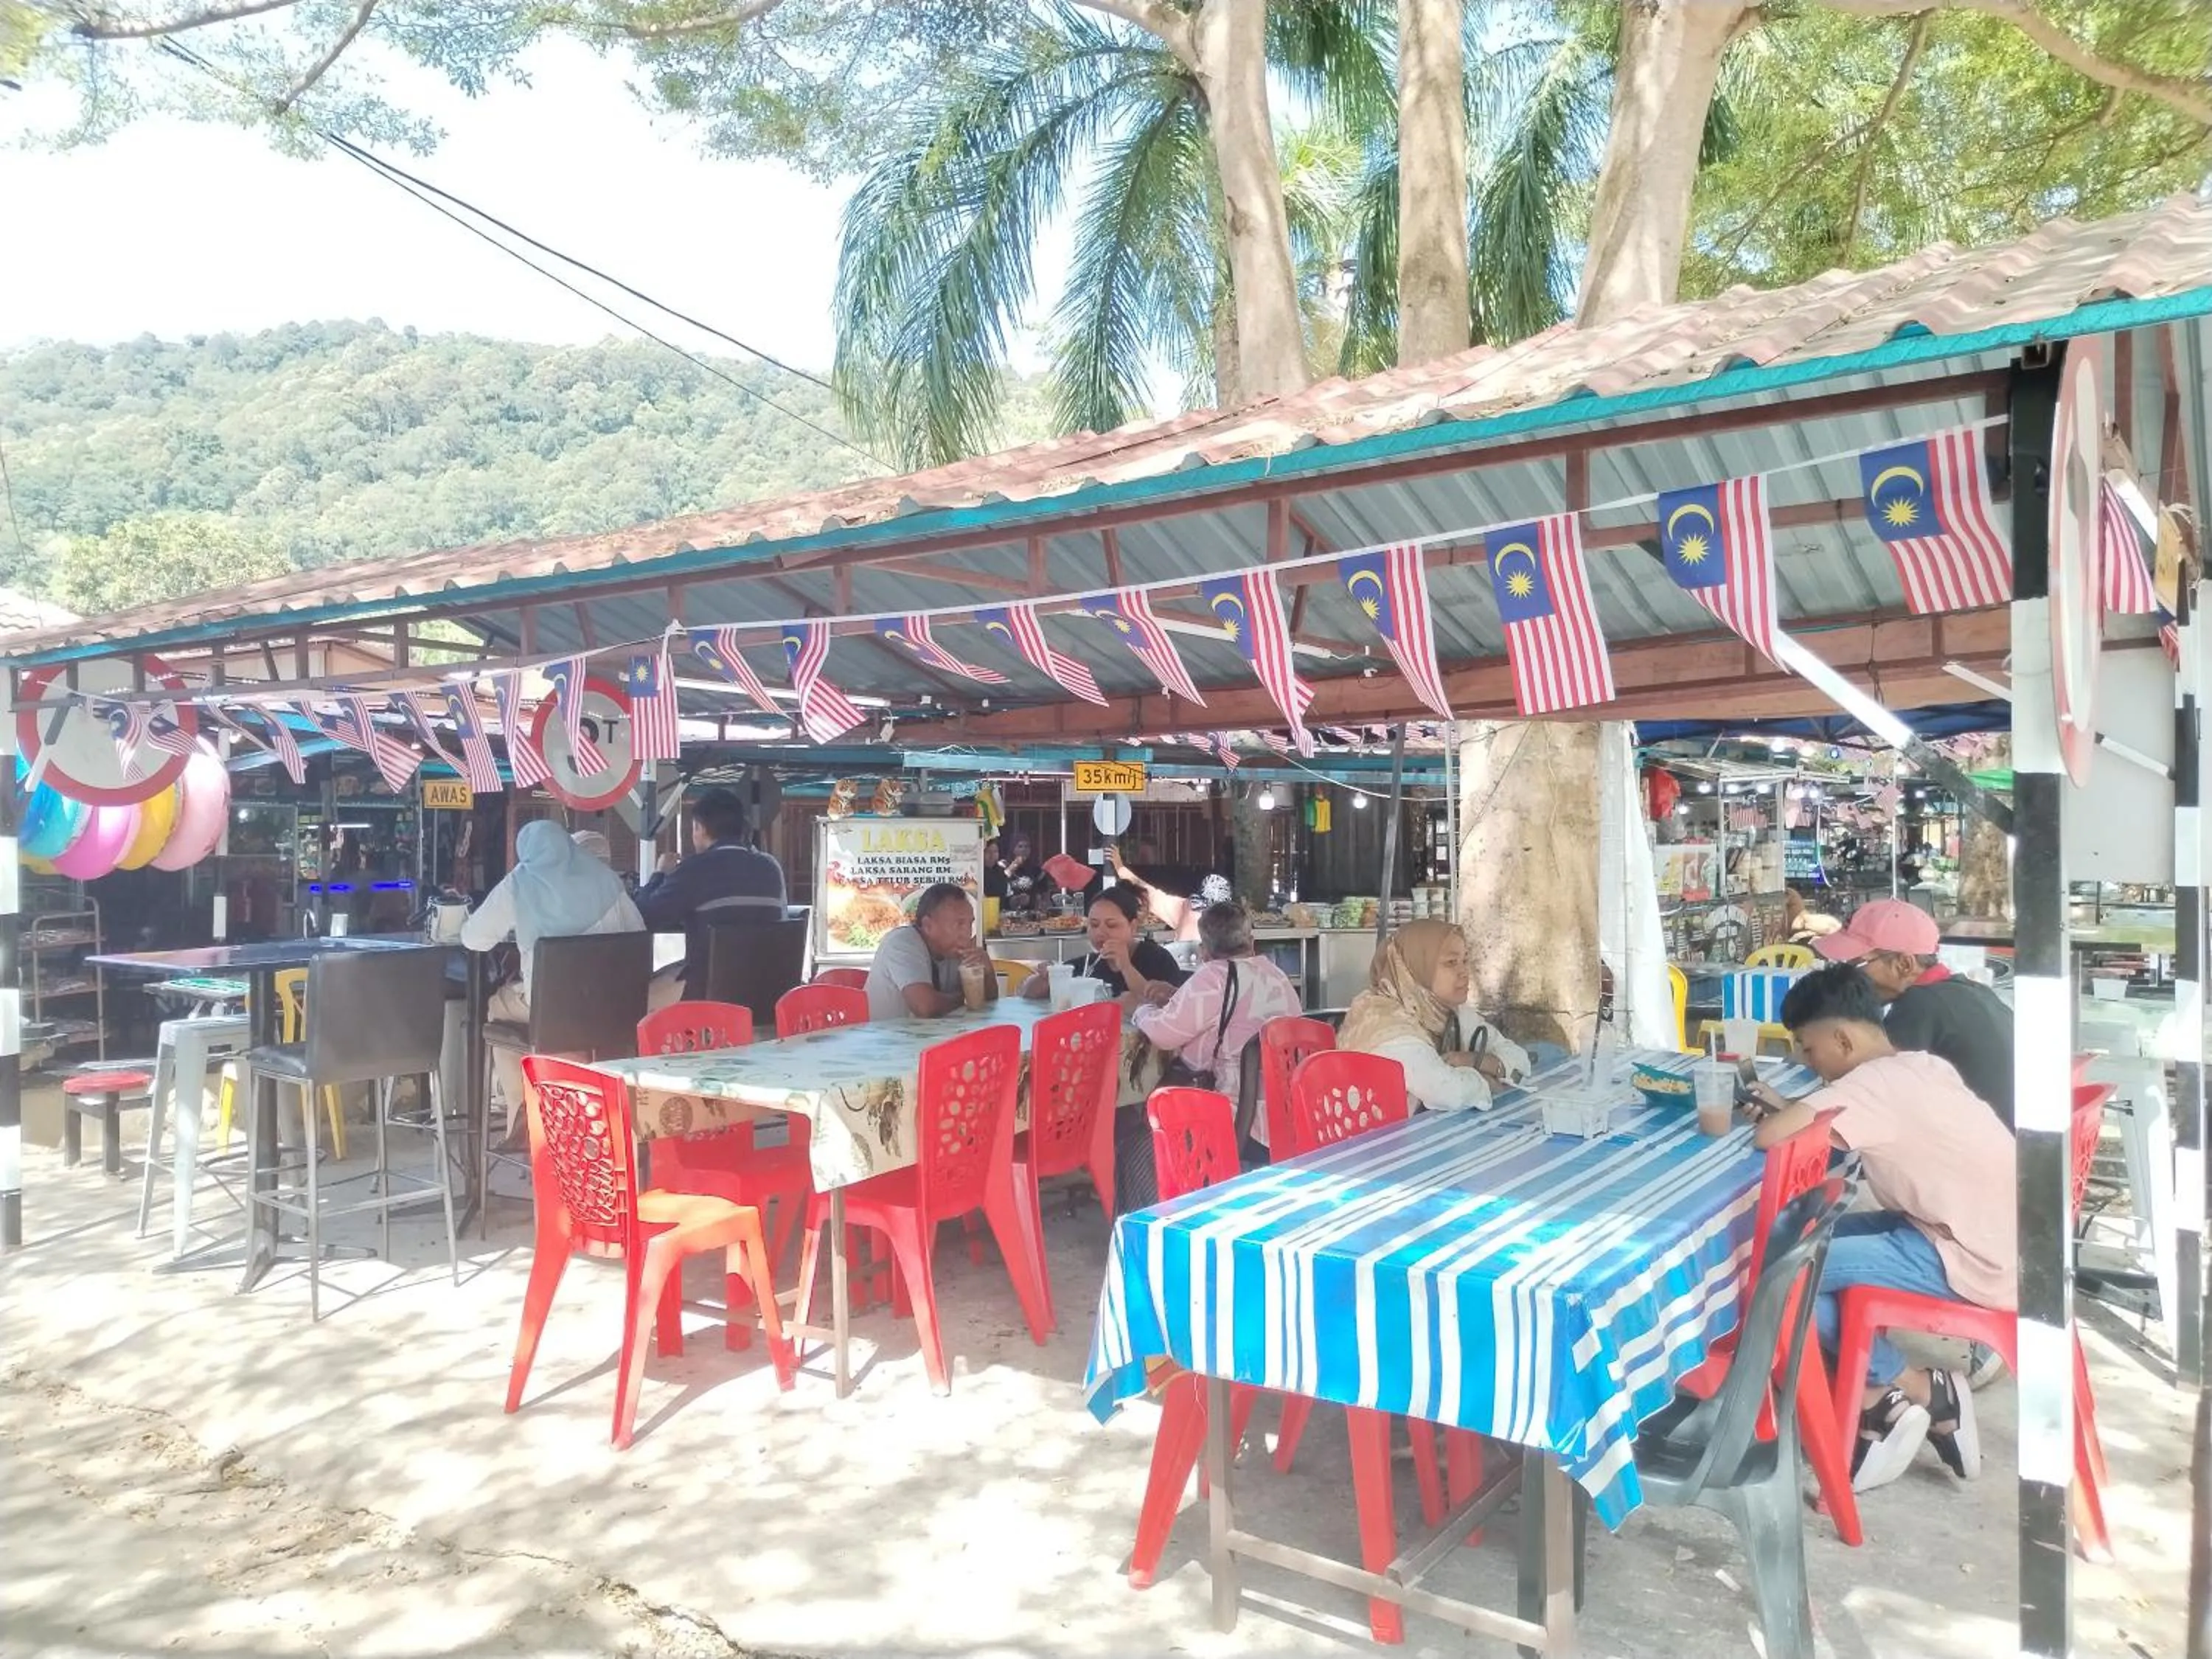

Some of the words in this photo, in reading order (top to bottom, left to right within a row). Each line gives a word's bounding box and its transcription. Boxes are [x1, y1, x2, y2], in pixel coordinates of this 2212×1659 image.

[430, 785, 467, 803] AWAS
[862, 827, 946, 853] LAKSA
[858, 856, 892, 865] LAKSA
[896, 856, 927, 865] BIASA
[850, 866, 886, 874] LAKSA
[888, 866, 933, 874] SARANG
[877, 876, 911, 884] TELUR
